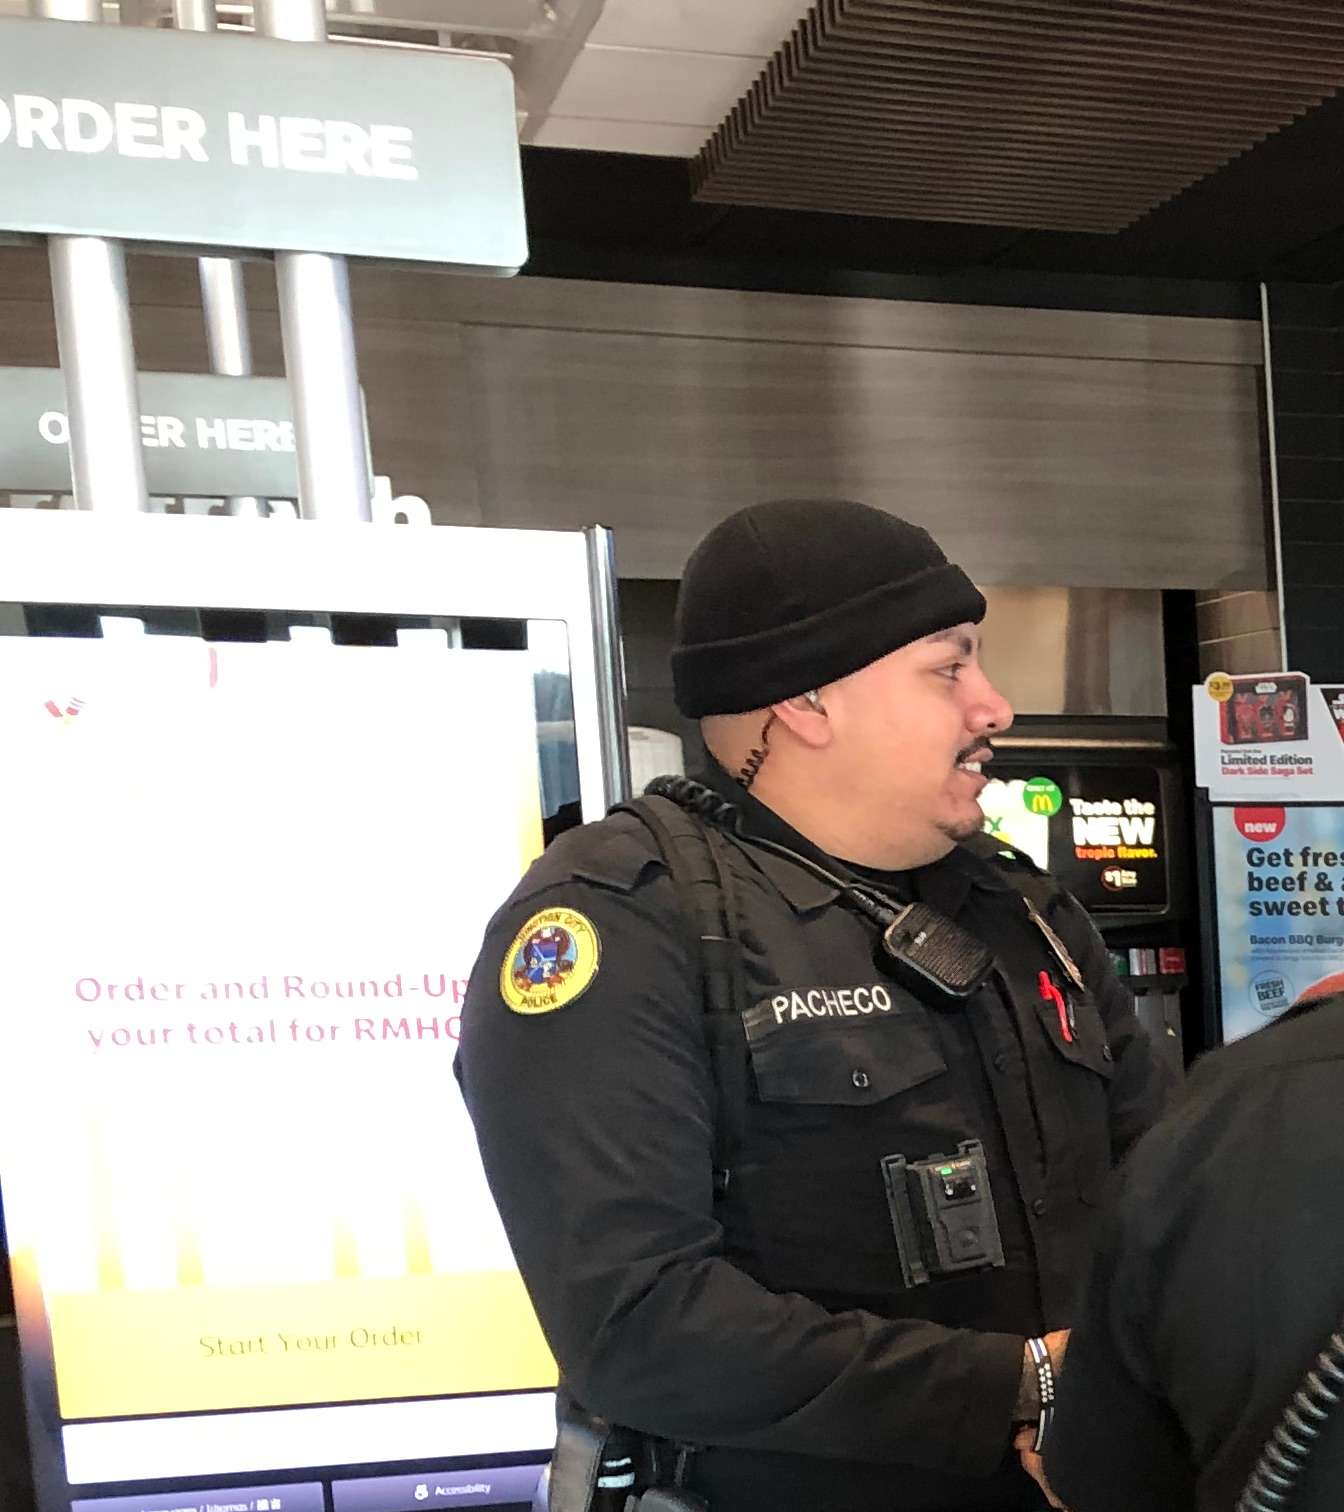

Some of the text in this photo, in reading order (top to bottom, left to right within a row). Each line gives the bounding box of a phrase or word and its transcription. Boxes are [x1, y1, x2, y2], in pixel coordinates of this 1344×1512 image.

[0, 94, 418, 180] RDER HERE
[39, 411, 185, 449] OER
[1221, 754, 1313, 765] Limited Edition
[1247, 767, 1268, 775] Side
[1069, 798, 1155, 816] Taste the
[1072, 816, 1156, 845] NEW
[1244, 822, 1277, 833] new
[1246, 847, 1294, 868] Get
[1247, 871, 1308, 892] beef
[1314, 872, 1334, 892] &
[1249, 897, 1330, 916] sweet
[1250, 935, 1285, 945] Bacon
[1288, 935, 1314, 945] BBQ
[75, 976, 187, 1003] Order
[200, 976, 270, 1001] and
[1255, 979, 1284, 991] FRESH
[1257, 988, 1285, 1001] BEEF
[520, 993, 558, 1008] POLICE
[771, 985, 892, 1024] PACHECO
[87, 1023, 174, 1053] your
[188, 1020, 276, 1046] total
[288, 1018, 341, 1043] for
[199, 1326, 424, 1359] Start Your Order
[435, 1482, 491, 1496] Accessibility
